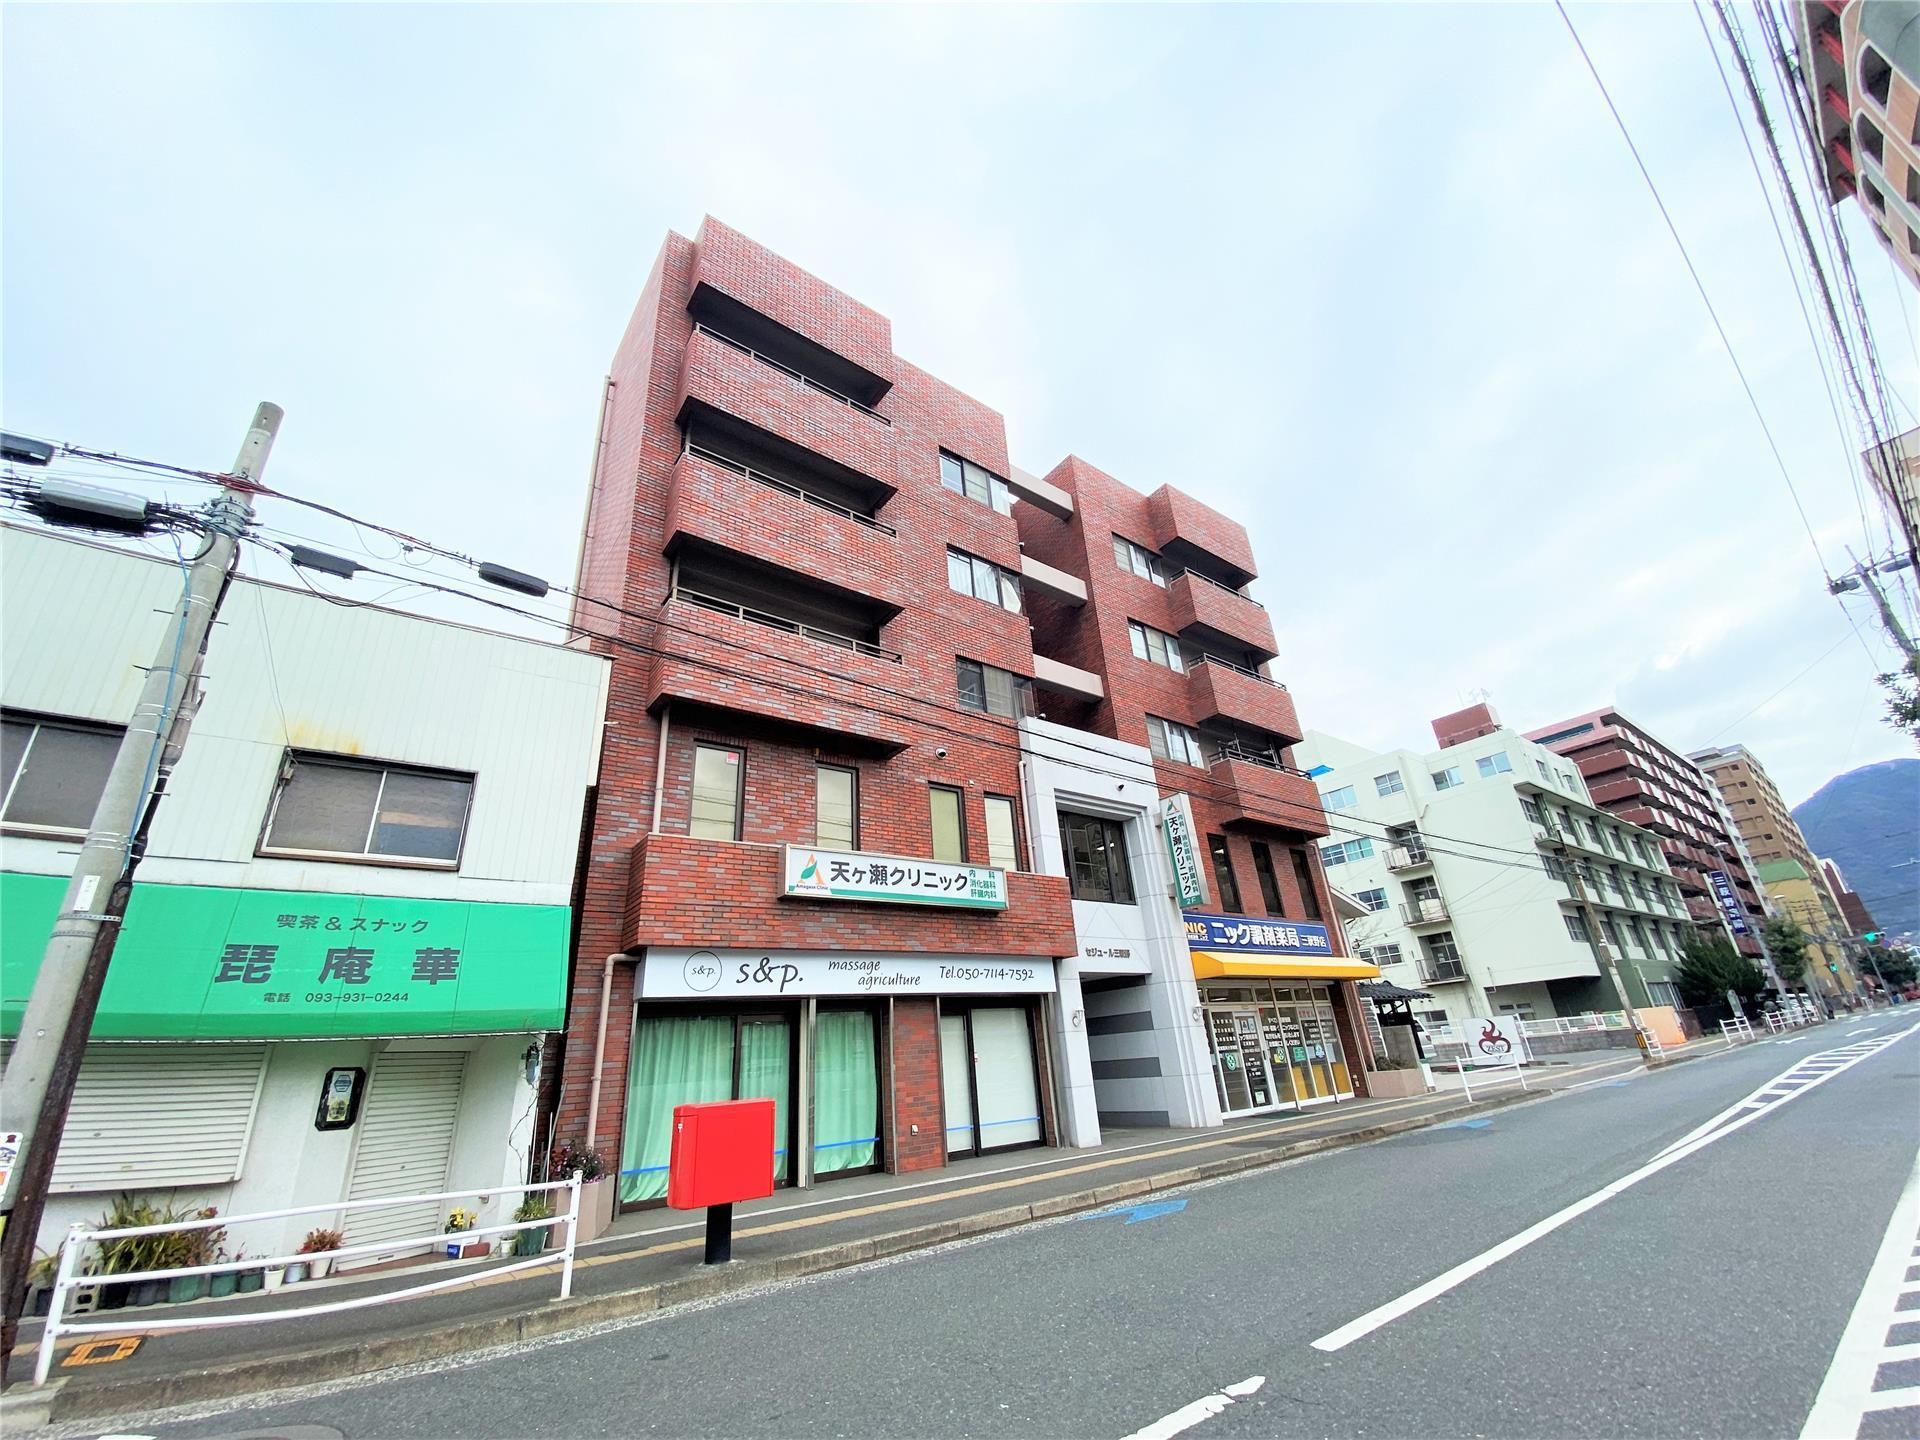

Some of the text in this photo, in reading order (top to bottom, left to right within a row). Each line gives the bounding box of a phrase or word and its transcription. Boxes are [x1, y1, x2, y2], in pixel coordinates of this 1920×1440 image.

[1168, 816, 1192, 896] 天ヶ瀬クリニック
[830, 860, 968, 892] 天ヶ瀬クリニック
[1211, 921, 1300, 948] ニック調剤薬局
[691, 965, 716, 978] s&p.
[736, 957, 804, 993] s&p.
[828, 960, 881, 975] massage
[939, 965, 1035, 982] Tel.050-7114-7592
[857, 972, 921, 991] agriculture
[263, 992, 409, 1003] 電話 093-931-0244
[1486, 1044, 1505, 1052] ZEST
